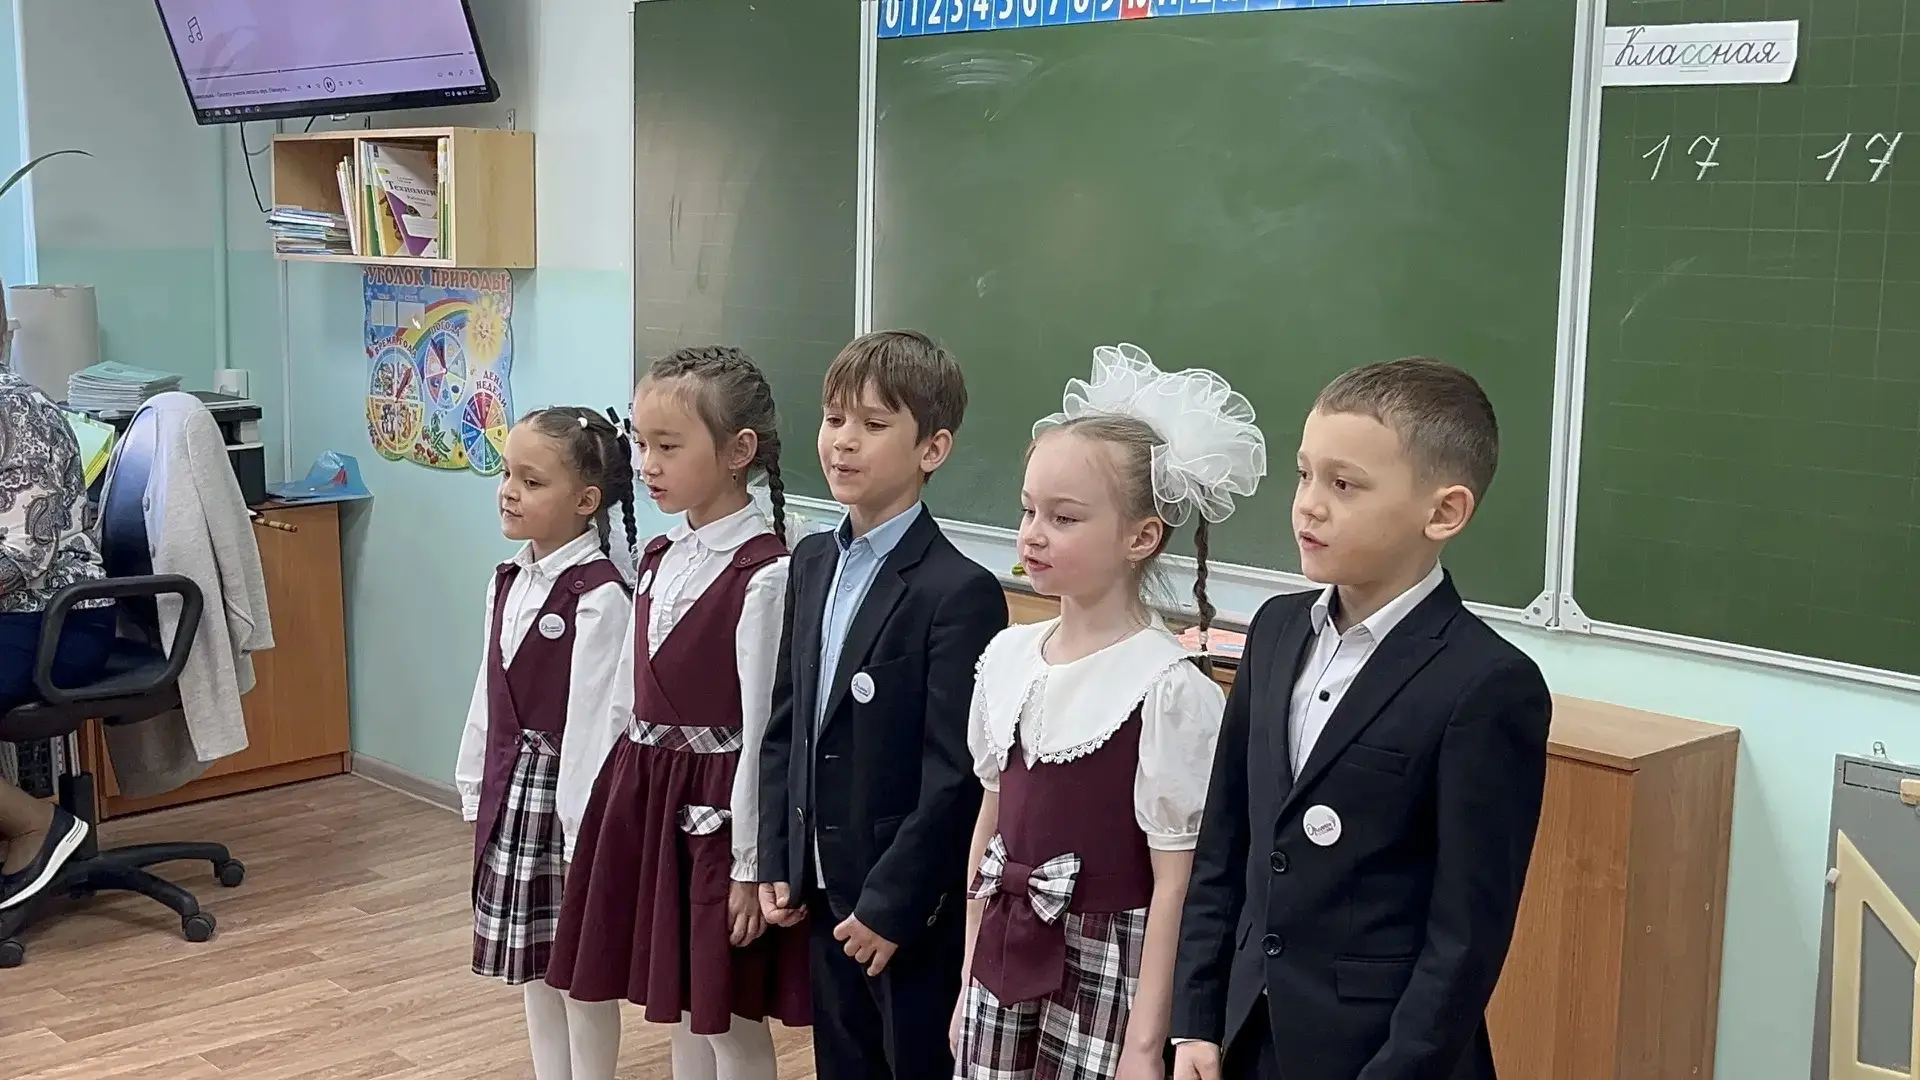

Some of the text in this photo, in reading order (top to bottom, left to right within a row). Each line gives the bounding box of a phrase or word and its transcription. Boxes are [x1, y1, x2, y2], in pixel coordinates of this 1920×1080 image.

[1614, 26, 1781, 66] Классная
[367, 266, 509, 292] УГОЛОК ПРИРОДЫ
[429, 320, 461, 338] ПОГОДА
[374, 336, 397, 355] ВРЕМЯ
[482, 369, 504, 390] ДЕНЬ
[476, 380, 508, 408] НЕДЕЛИ
